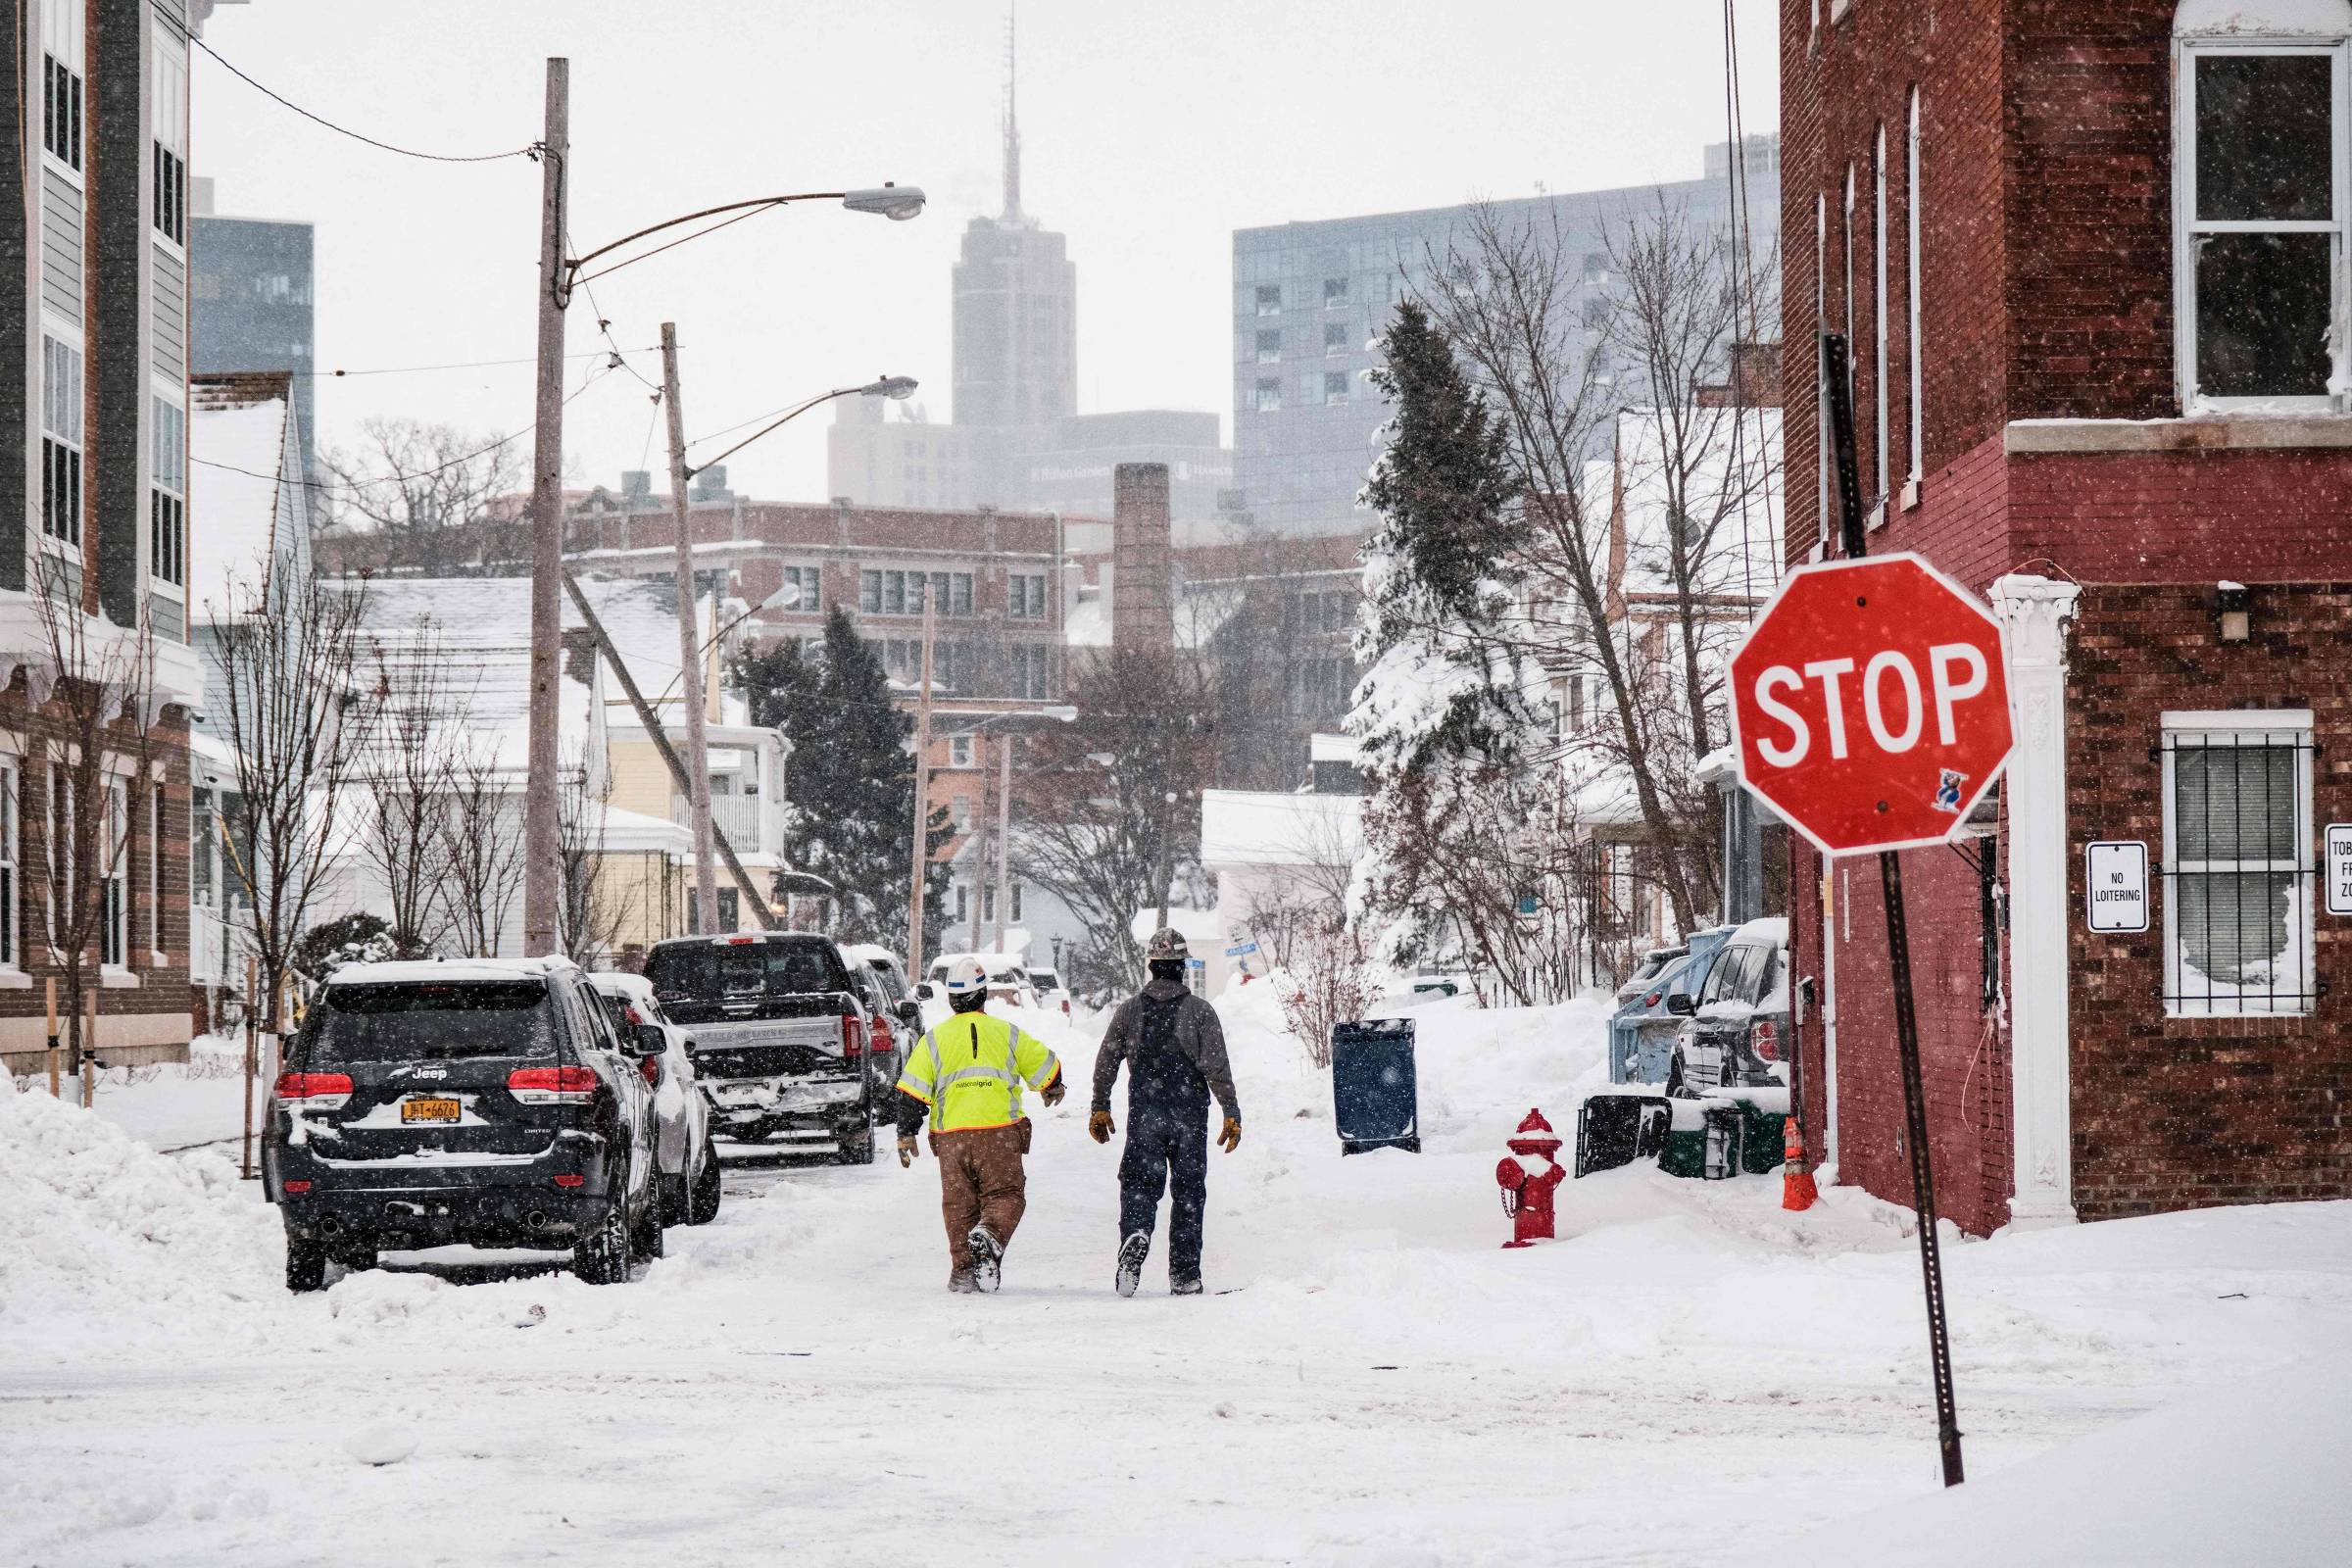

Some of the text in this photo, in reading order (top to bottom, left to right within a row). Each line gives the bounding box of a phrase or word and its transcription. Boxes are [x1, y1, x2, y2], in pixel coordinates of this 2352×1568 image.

[1754, 642, 1988, 768] STOP
[2111, 872, 2124, 884] NO
[2095, 890, 2140, 902] LOITERING
[412, 1068, 447, 1081] Jeep
